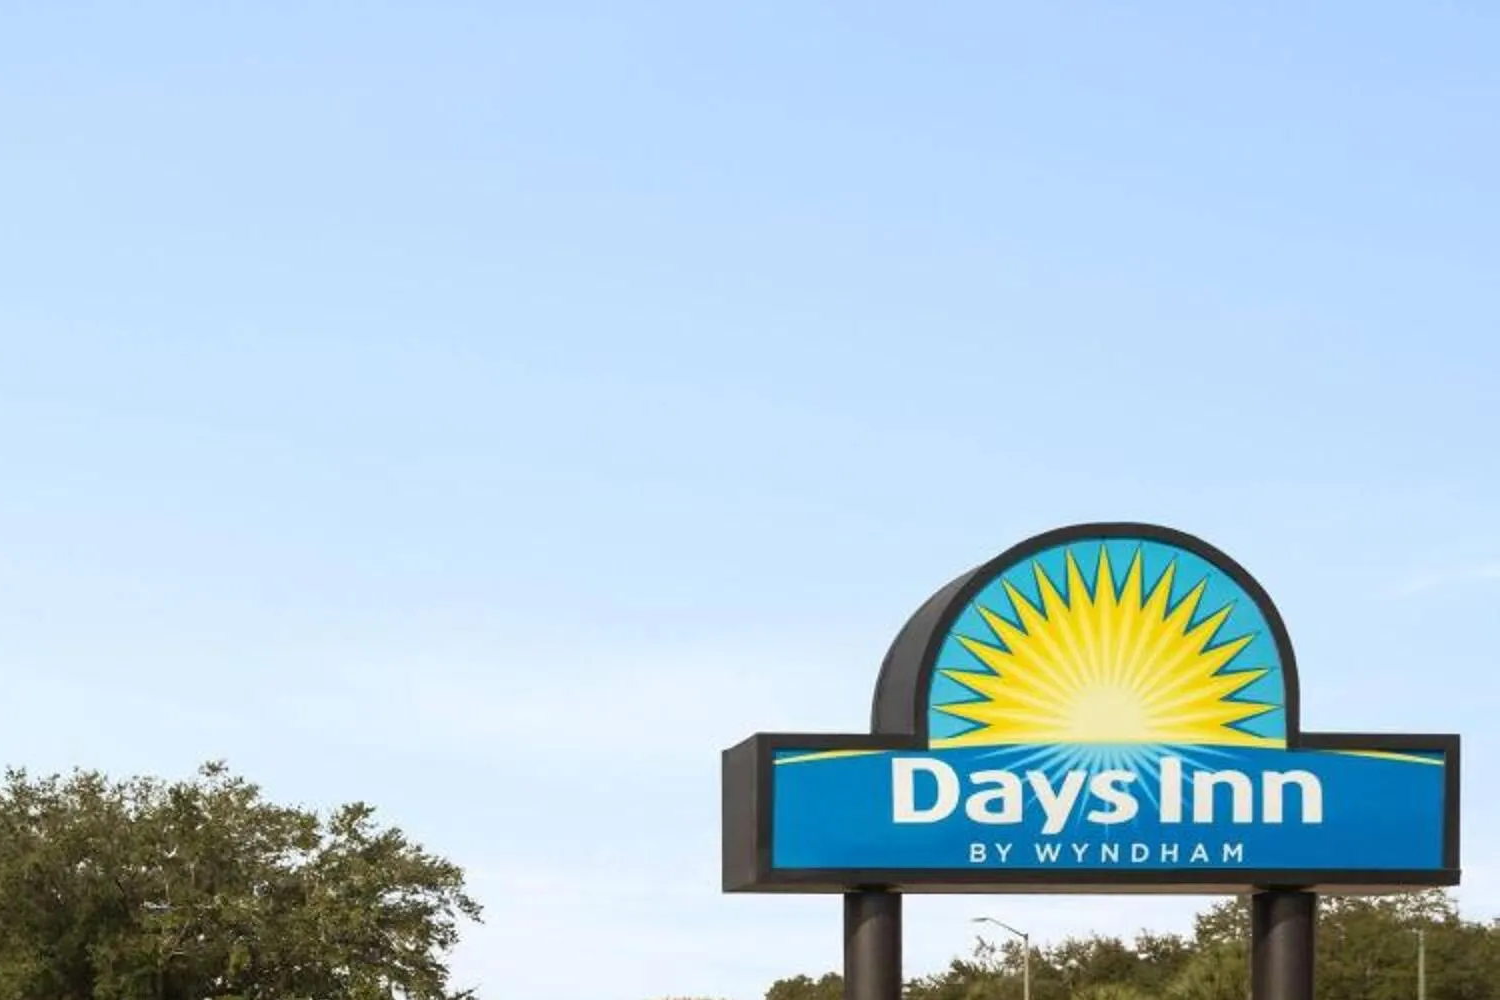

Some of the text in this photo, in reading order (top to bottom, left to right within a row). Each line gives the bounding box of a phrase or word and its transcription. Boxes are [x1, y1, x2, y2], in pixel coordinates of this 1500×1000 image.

[891, 757, 1324, 834] Days Inn
[969, 842, 1245, 863] BY WYNDHAM
